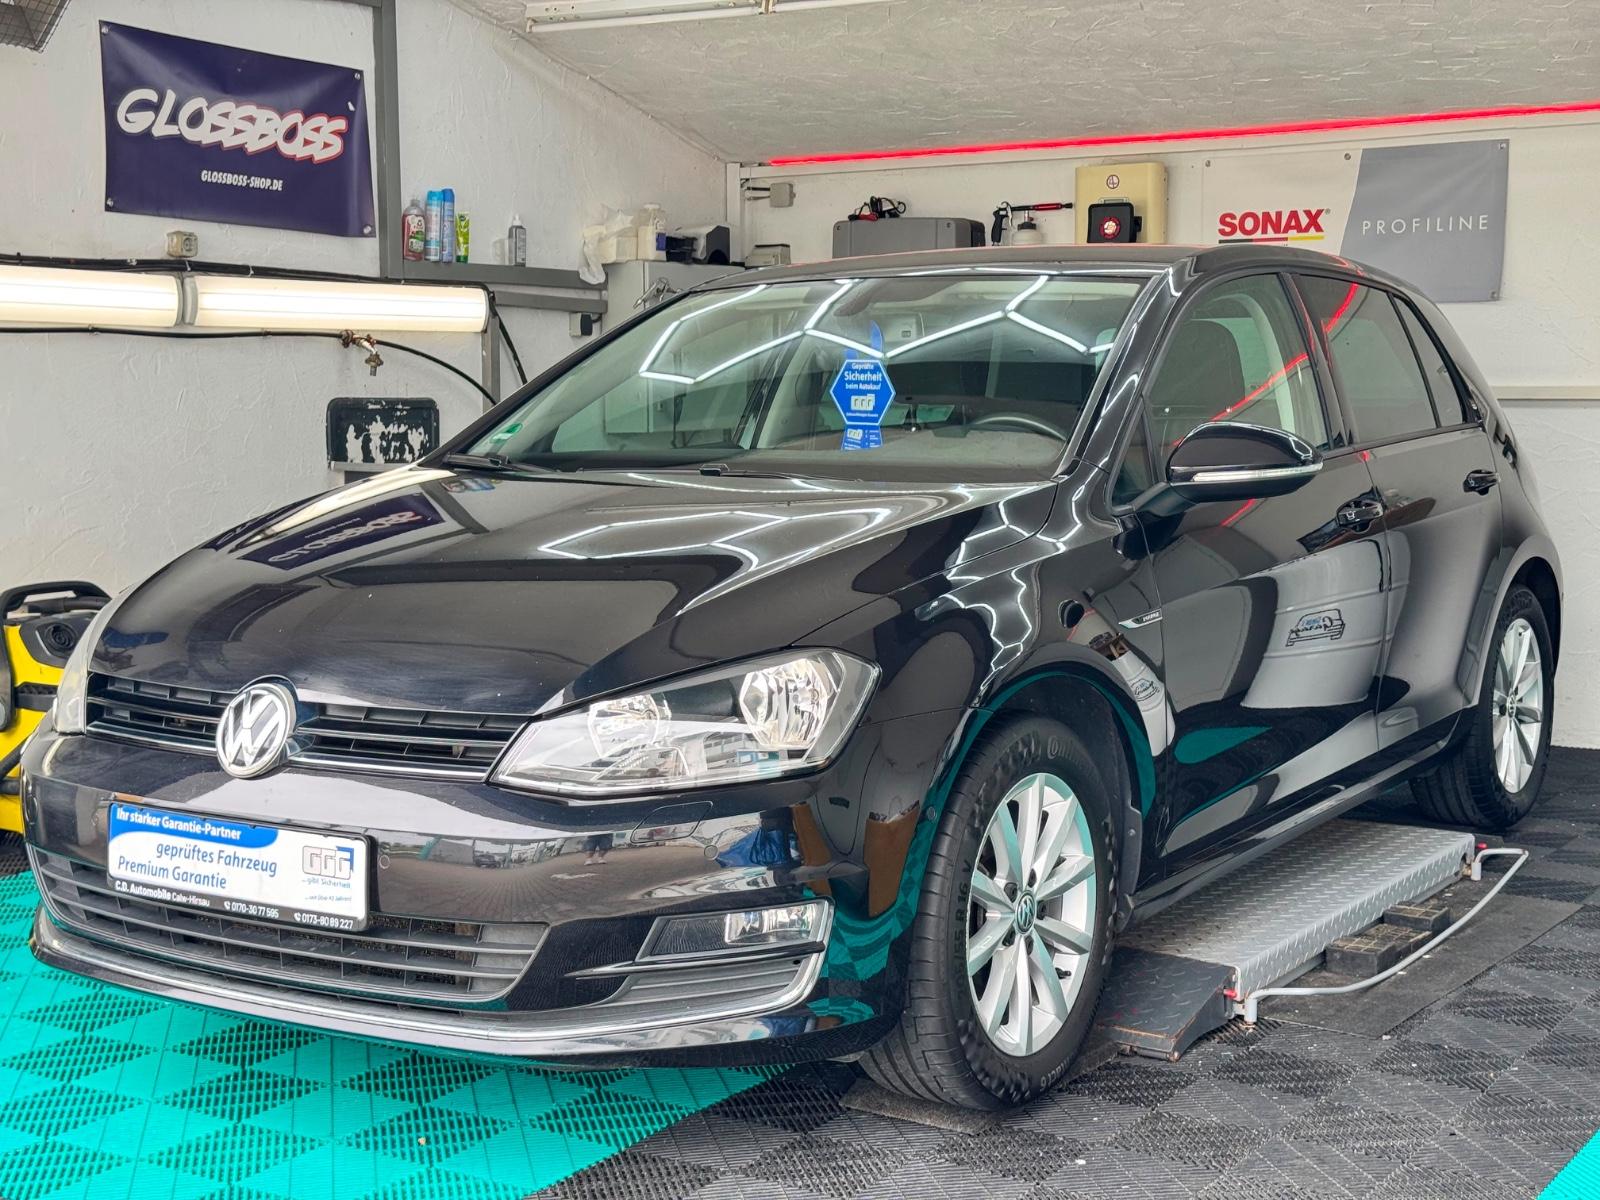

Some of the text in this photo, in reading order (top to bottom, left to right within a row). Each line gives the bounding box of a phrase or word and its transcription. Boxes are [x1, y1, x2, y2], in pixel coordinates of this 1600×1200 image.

[117, 88, 347, 163] GLOSSBOSS
[201, 170, 283, 191] GLOSSBOSS-SHOP.DE
[1218, 208, 1325, 237] SONAX
[1362, 214, 1489, 236] PROFILINE
[844, 371, 882, 381] Sicherheit
[116, 808, 242, 840] Ihr starker Garantie-Partner
[118, 855, 227, 889] Premium Garantie
[156, 843, 278, 877] geprüftes Fahrzeug
[115, 881, 129, 892] C.D.
[130, 884, 171, 901] Automobile
[172, 893, 210, 907] Calw-Hirsau
[258, 905, 265, 916] 77
[340, 919, 354, 930] 227
[957, 882, 968, 903] 16
[954, 907, 966, 922] R
